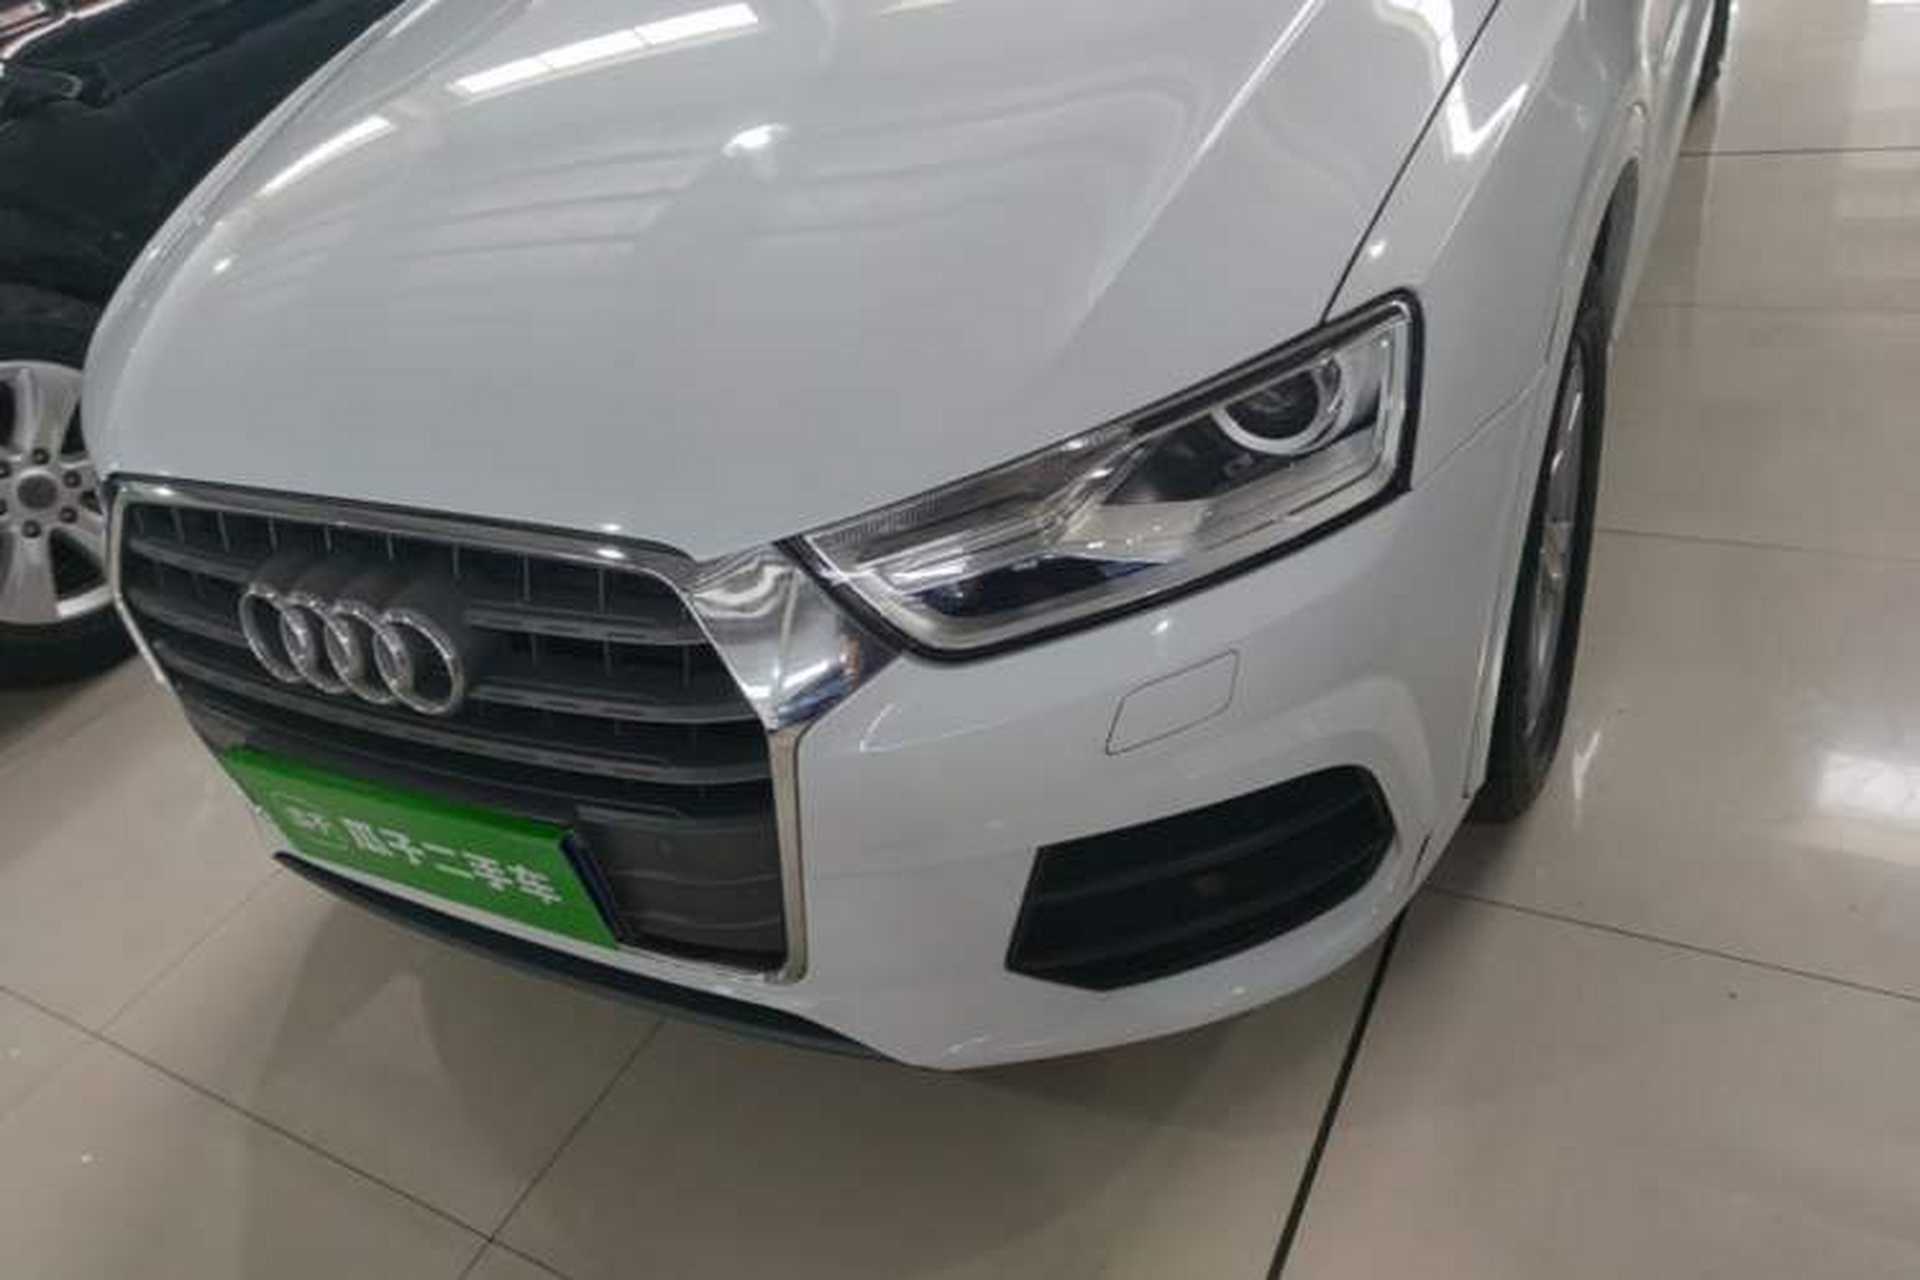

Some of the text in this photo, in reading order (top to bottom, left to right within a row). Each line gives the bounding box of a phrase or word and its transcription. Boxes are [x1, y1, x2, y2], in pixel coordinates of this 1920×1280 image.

[342, 817, 562, 905] 瓜子二手车
